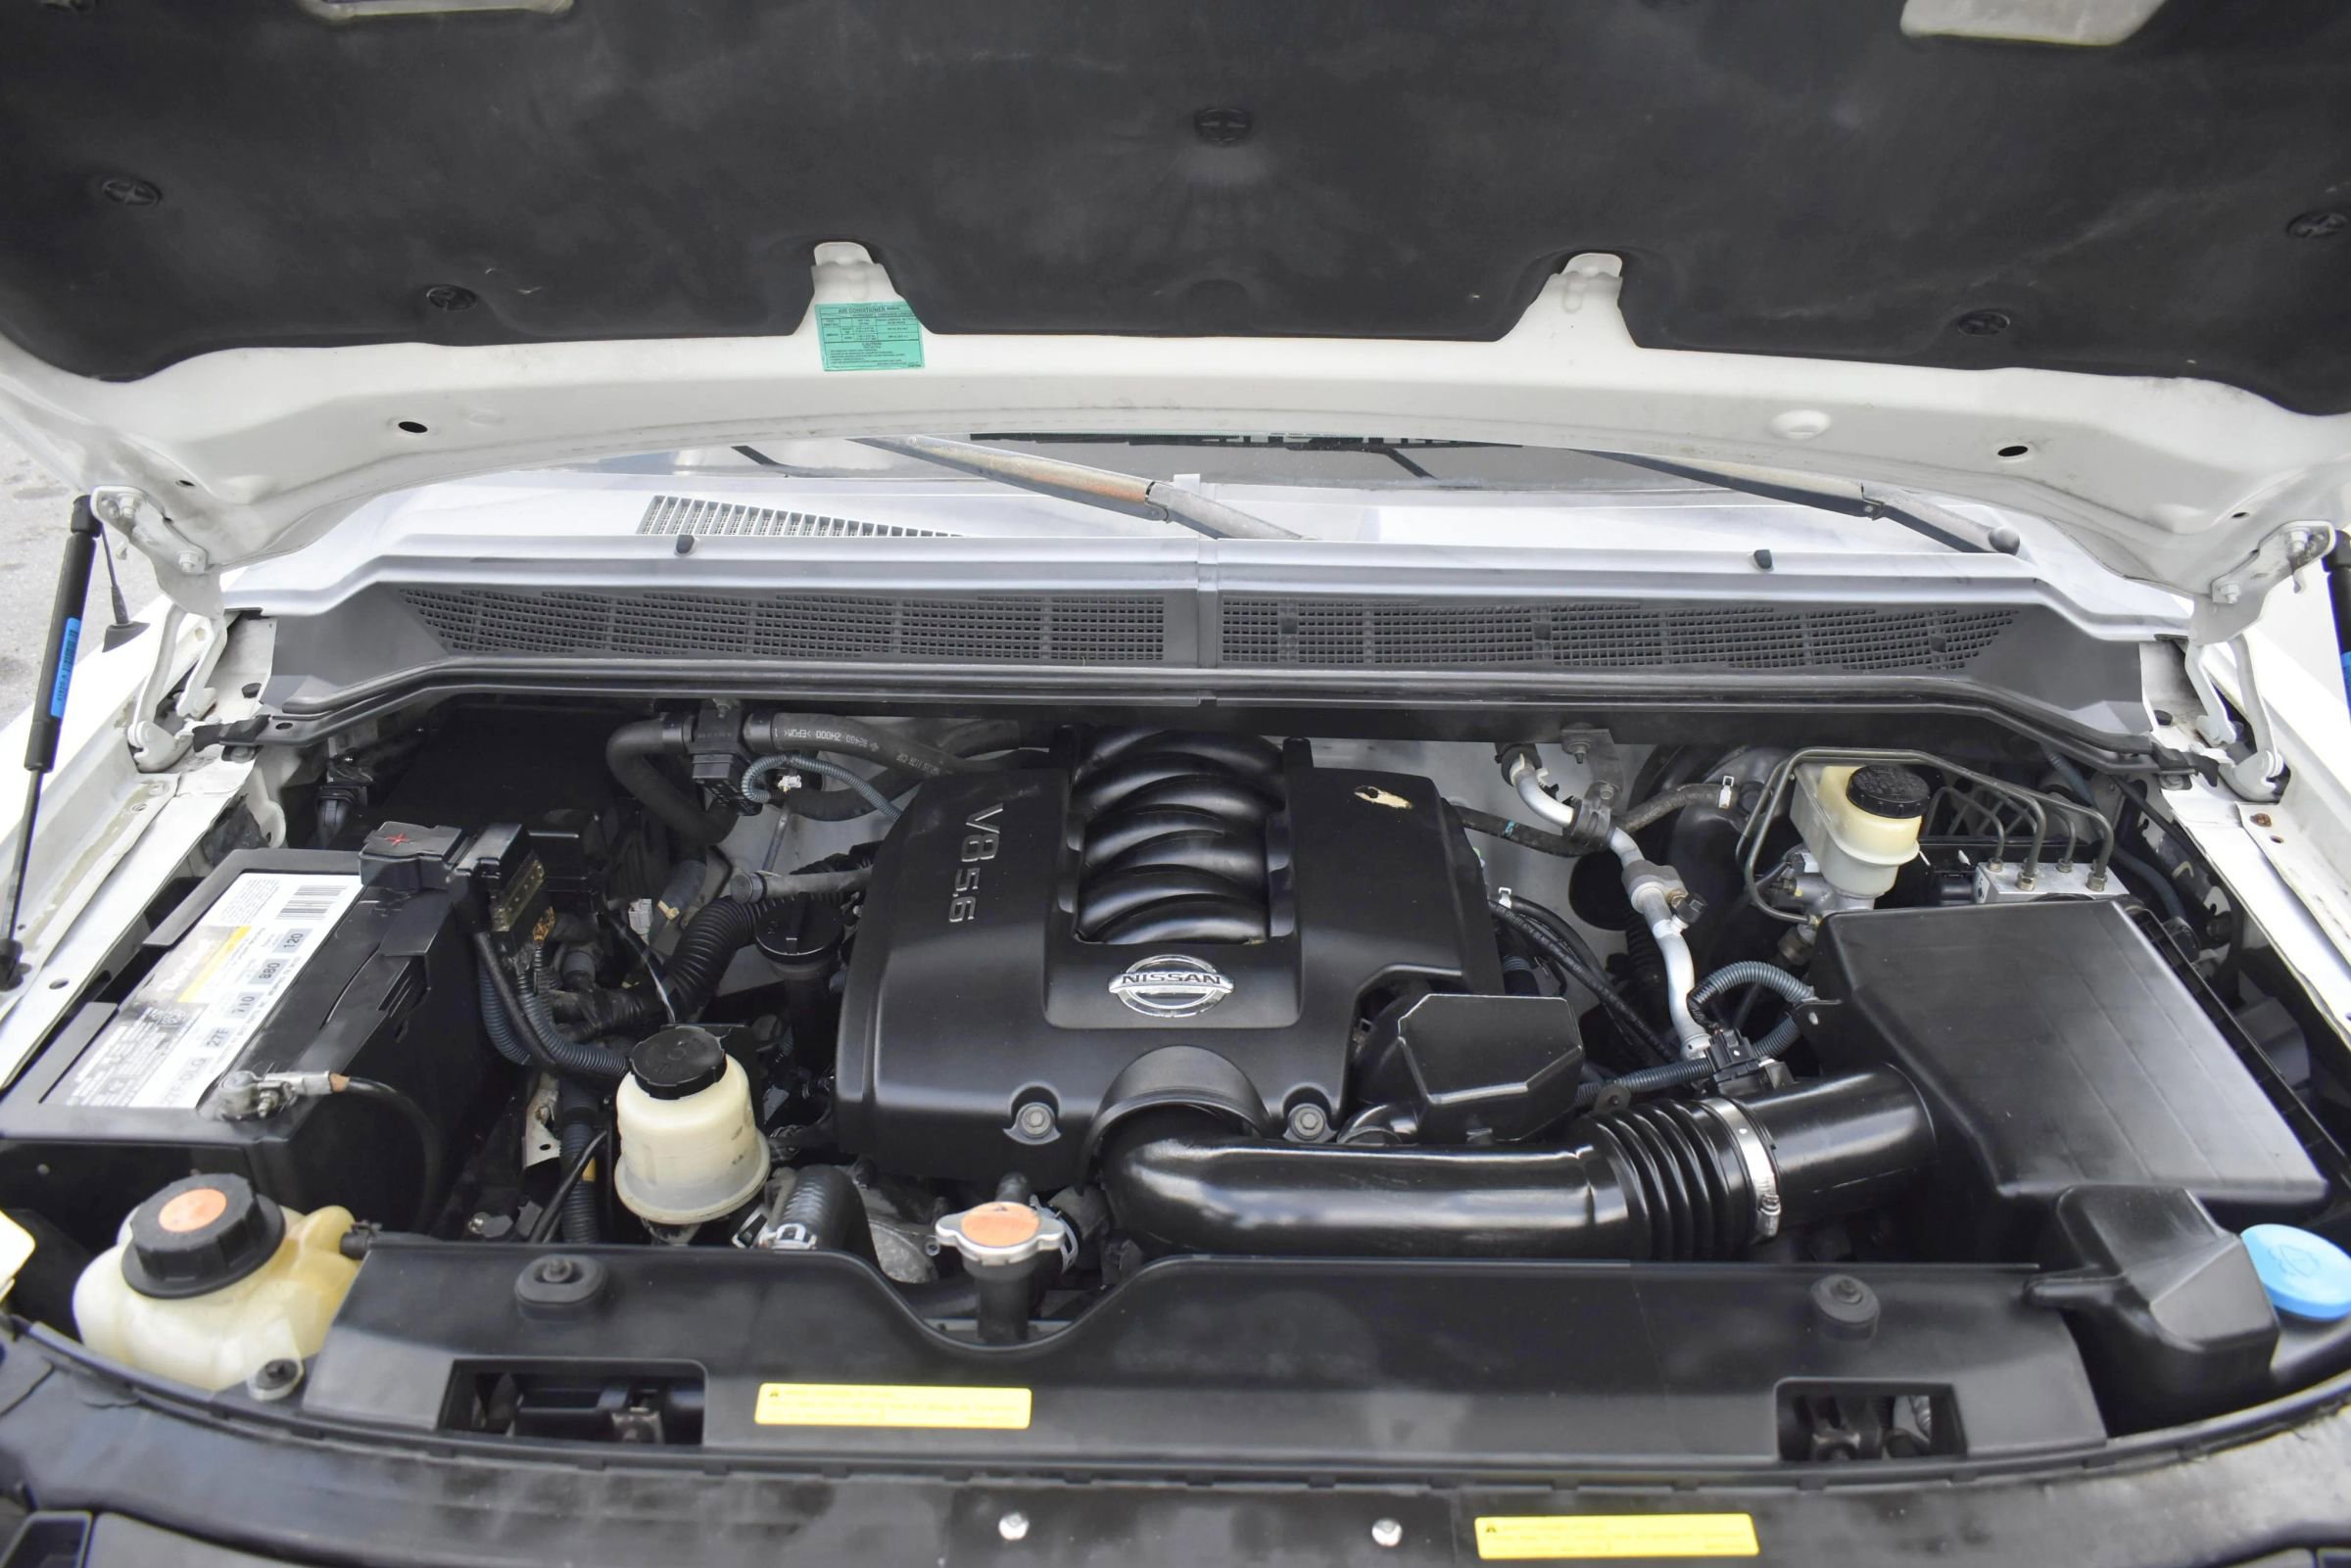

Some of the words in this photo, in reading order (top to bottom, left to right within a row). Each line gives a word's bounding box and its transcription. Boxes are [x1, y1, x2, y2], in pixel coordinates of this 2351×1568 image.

[961, 802, 1004, 862] V8
[283, 932, 304, 948] 120
[259, 962, 281, 979] 880
[1122, 972, 1222, 985] NISSAN
[231, 996, 256, 1014] 710
[206, 1026, 228, 1047] 27F
